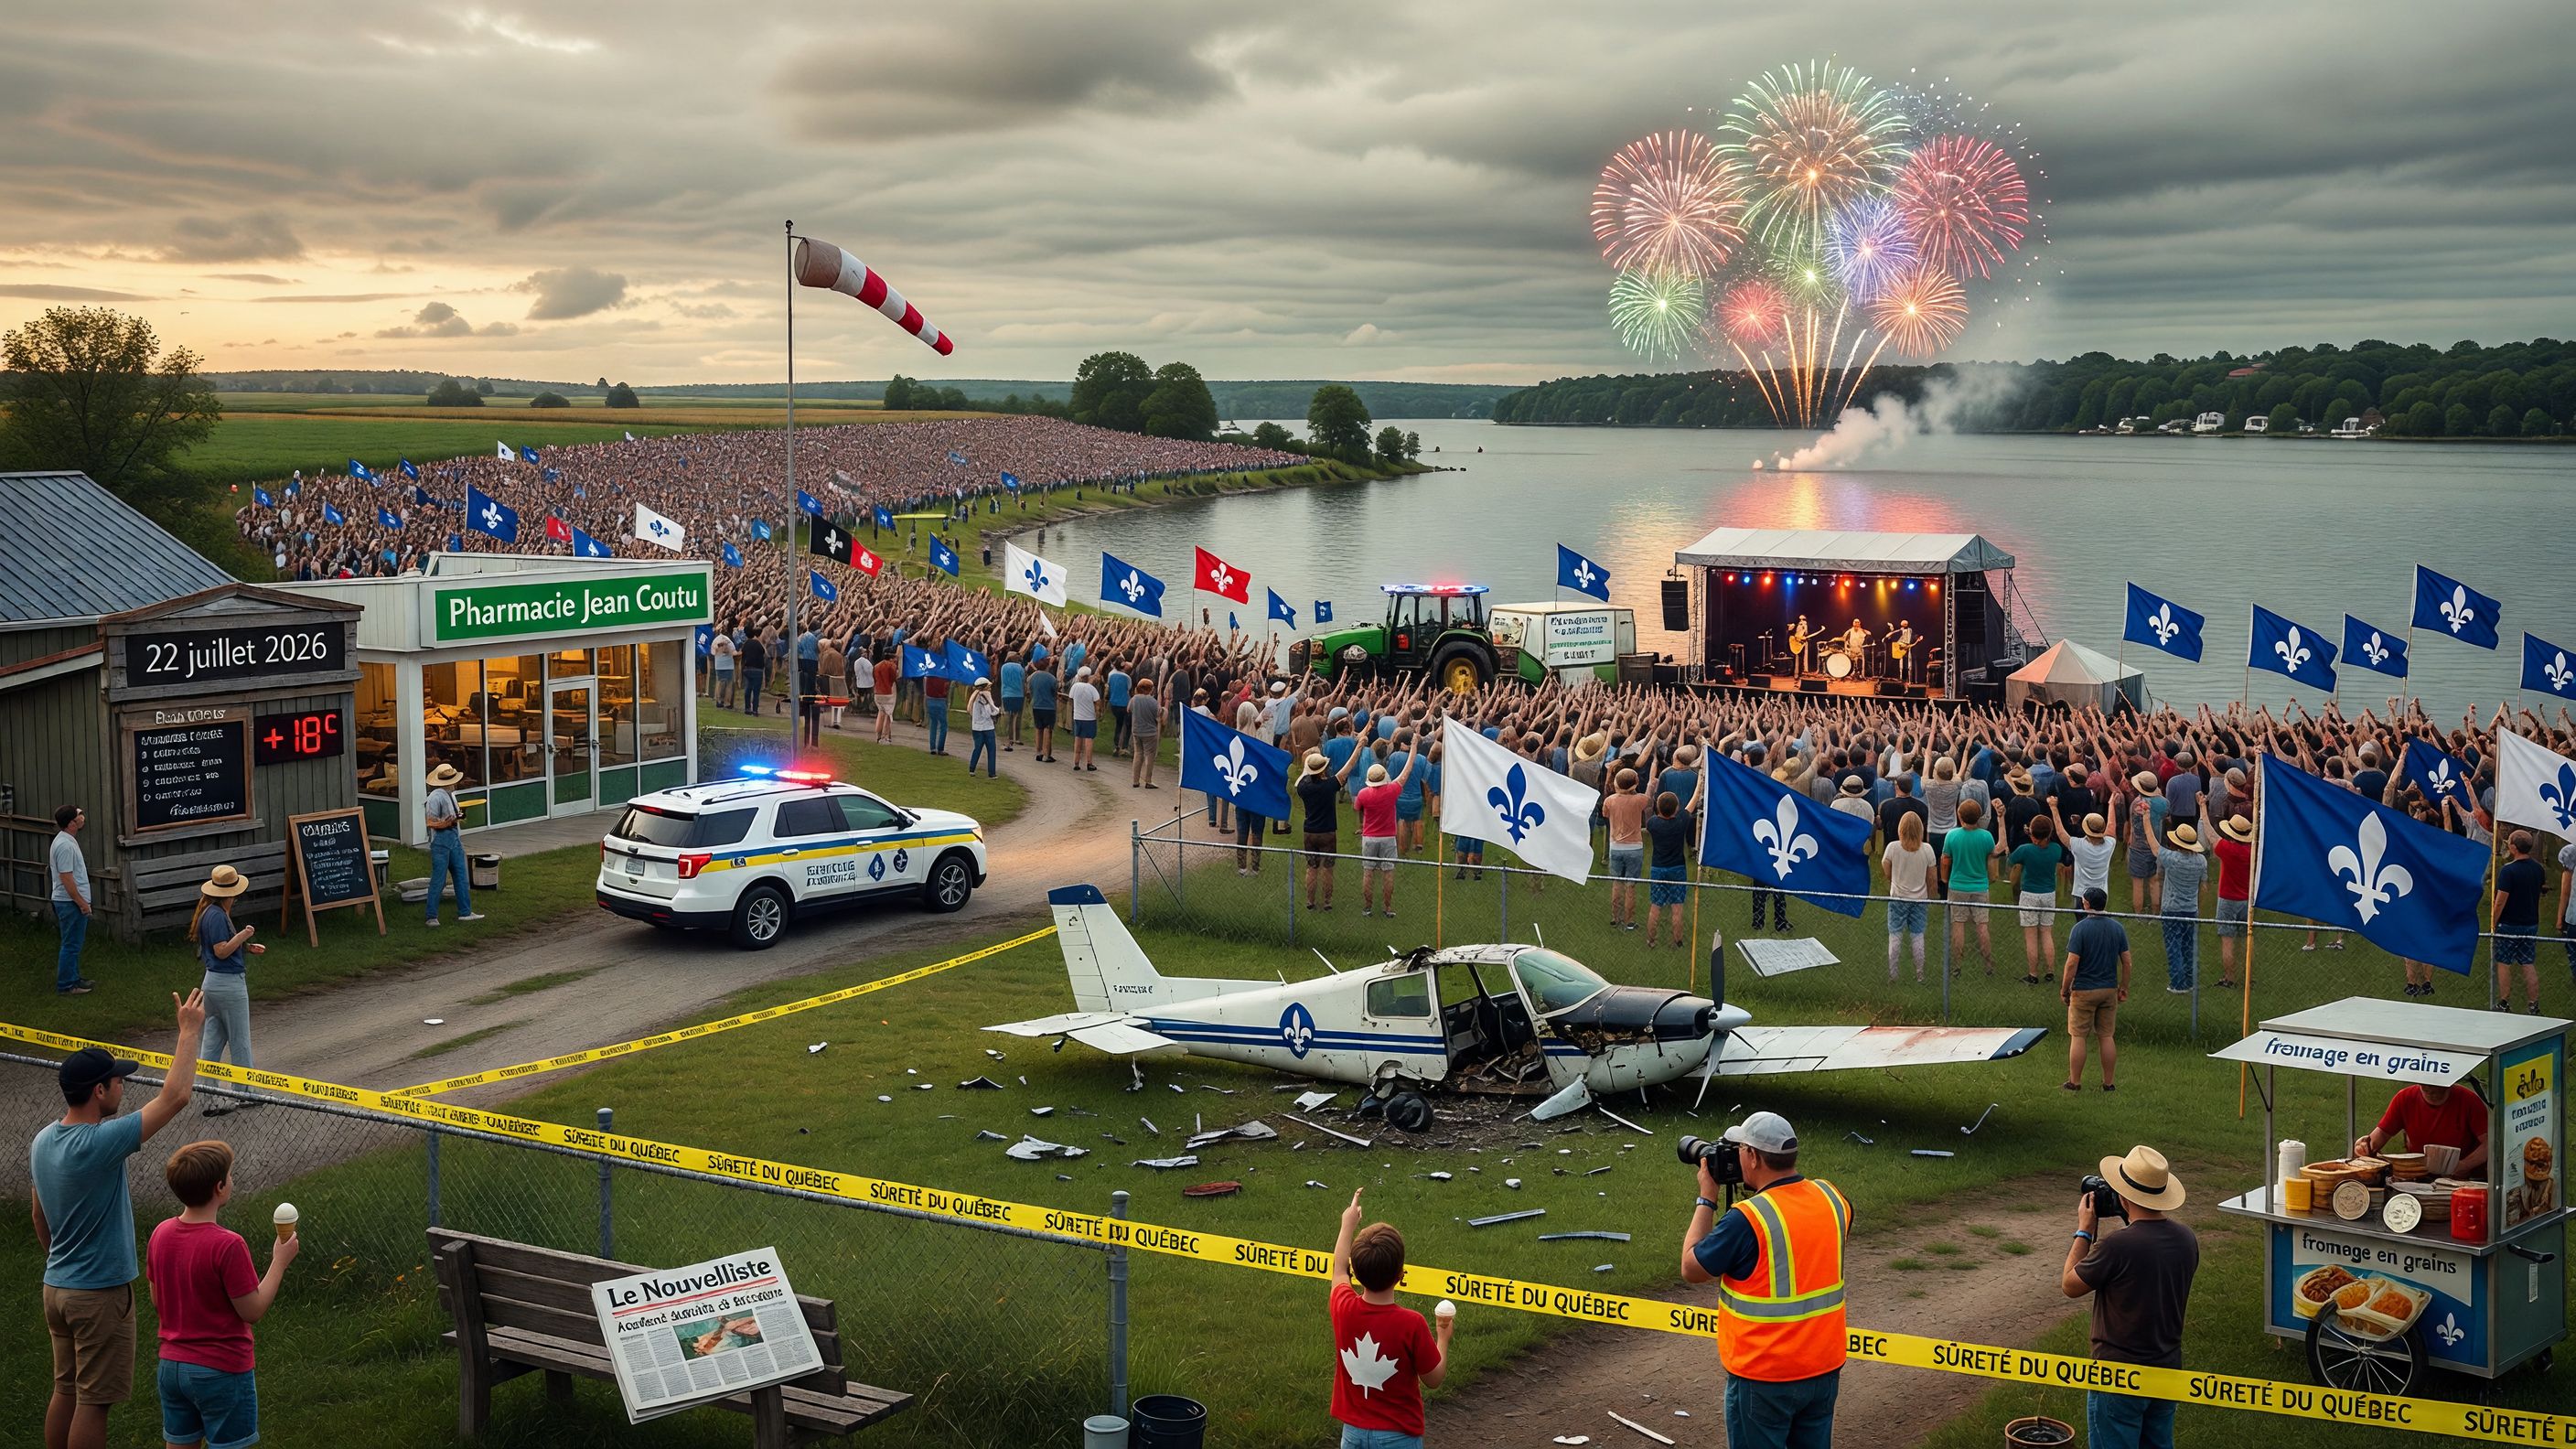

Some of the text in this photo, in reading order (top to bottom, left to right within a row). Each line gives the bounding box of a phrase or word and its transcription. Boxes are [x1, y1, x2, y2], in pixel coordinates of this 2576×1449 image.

[449, 584, 698, 628] Pharmacie Jean Coutu
[145, 631, 327, 679] 22 juillet 2026
[2355, 1052, 2379, 1066] en
[2387, 1053, 2451, 1075] grains
[762, 1165, 780, 1181] DU
[928, 1193, 947, 1210] DU
[1135, 1228, 1200, 1254] QUÉBEC
[1235, 1242, 1328, 1274] SÛRETÉ DU
[2377, 1250, 2398, 1265] en
[2403, 1253, 2457, 1274] grains
[606, 1287, 639, 1309] Le
[639, 1260, 772, 1303] Nouvelliste
[1445, 1273, 1630, 1321] SÛRETÉ DU QUÉBEC
[1669, 1307, 1888, 1357] SÛRE BEC
[1933, 1342, 2141, 1390] SÛRETÉ DU QUÉBEC
[2189, 1375, 2412, 1424] SÛRETÉ DU QUÉBEC
[2464, 1408, 2576, 1444] SÛRETÉ D
